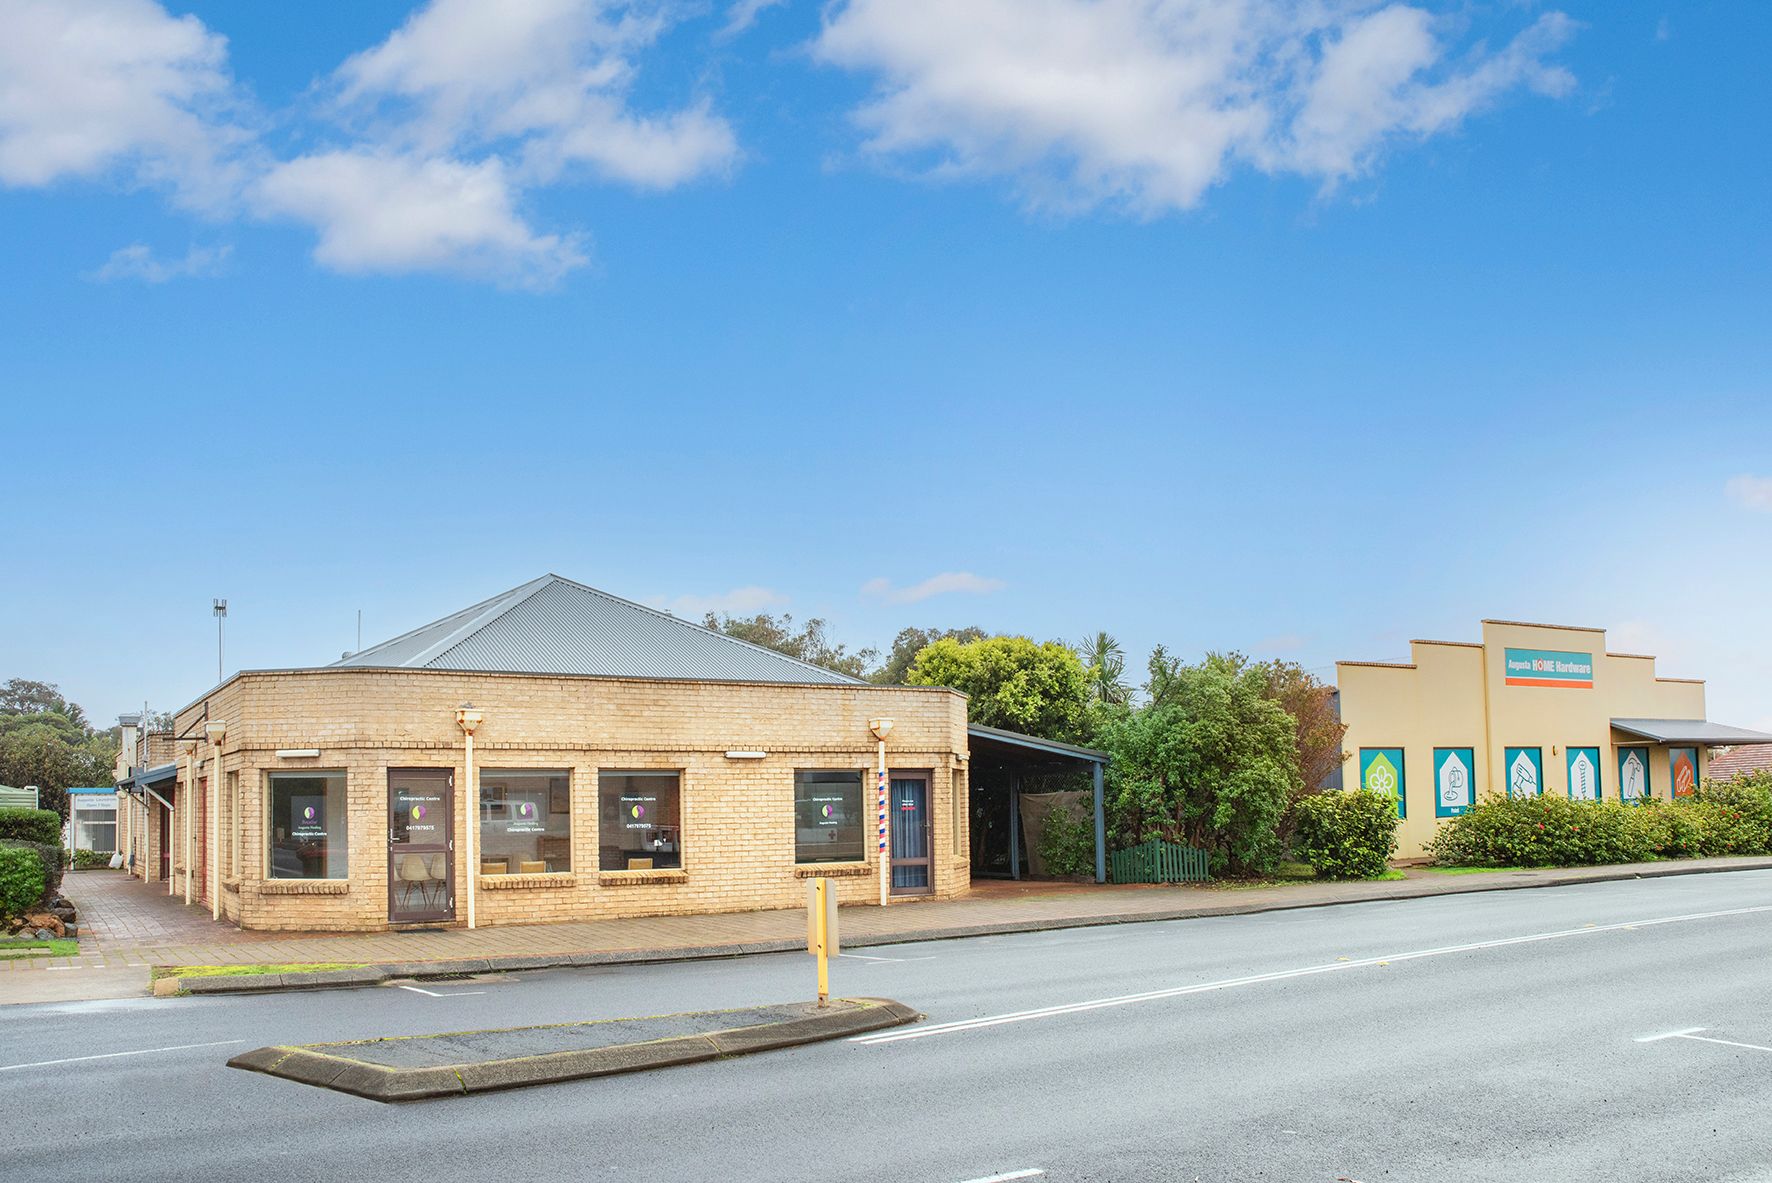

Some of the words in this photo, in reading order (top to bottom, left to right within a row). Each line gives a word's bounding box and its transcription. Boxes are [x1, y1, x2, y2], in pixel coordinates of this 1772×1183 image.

[1508, 659, 1531, 671] Augusta
[1532, 658, 1555, 672] HOME
[1555, 660, 1591, 674] Hardware
